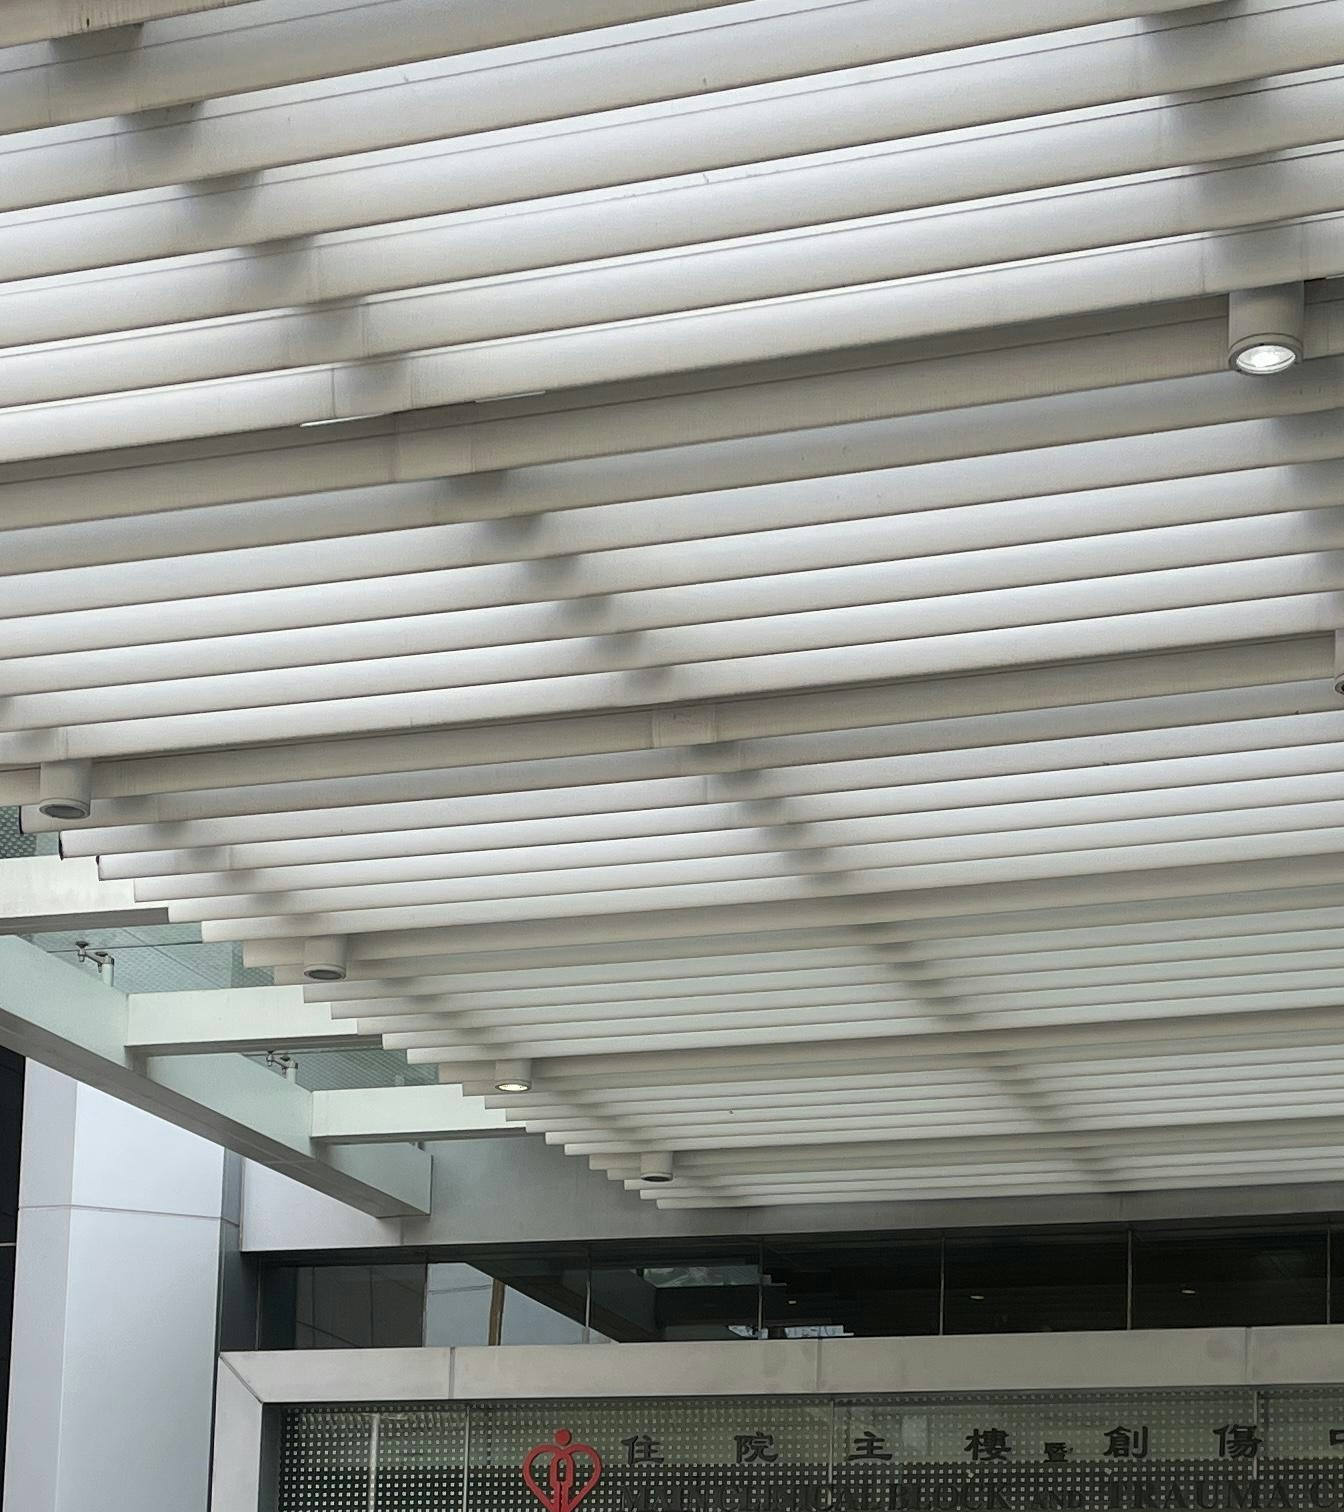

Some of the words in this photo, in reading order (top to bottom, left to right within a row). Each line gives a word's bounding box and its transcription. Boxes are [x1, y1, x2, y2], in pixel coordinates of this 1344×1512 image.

[888, 1481, 1012, 1511] BLOCK
[1032, 1488, 1084, 1510] AND
[1107, 1480, 1292, 1510] TRAUMA
